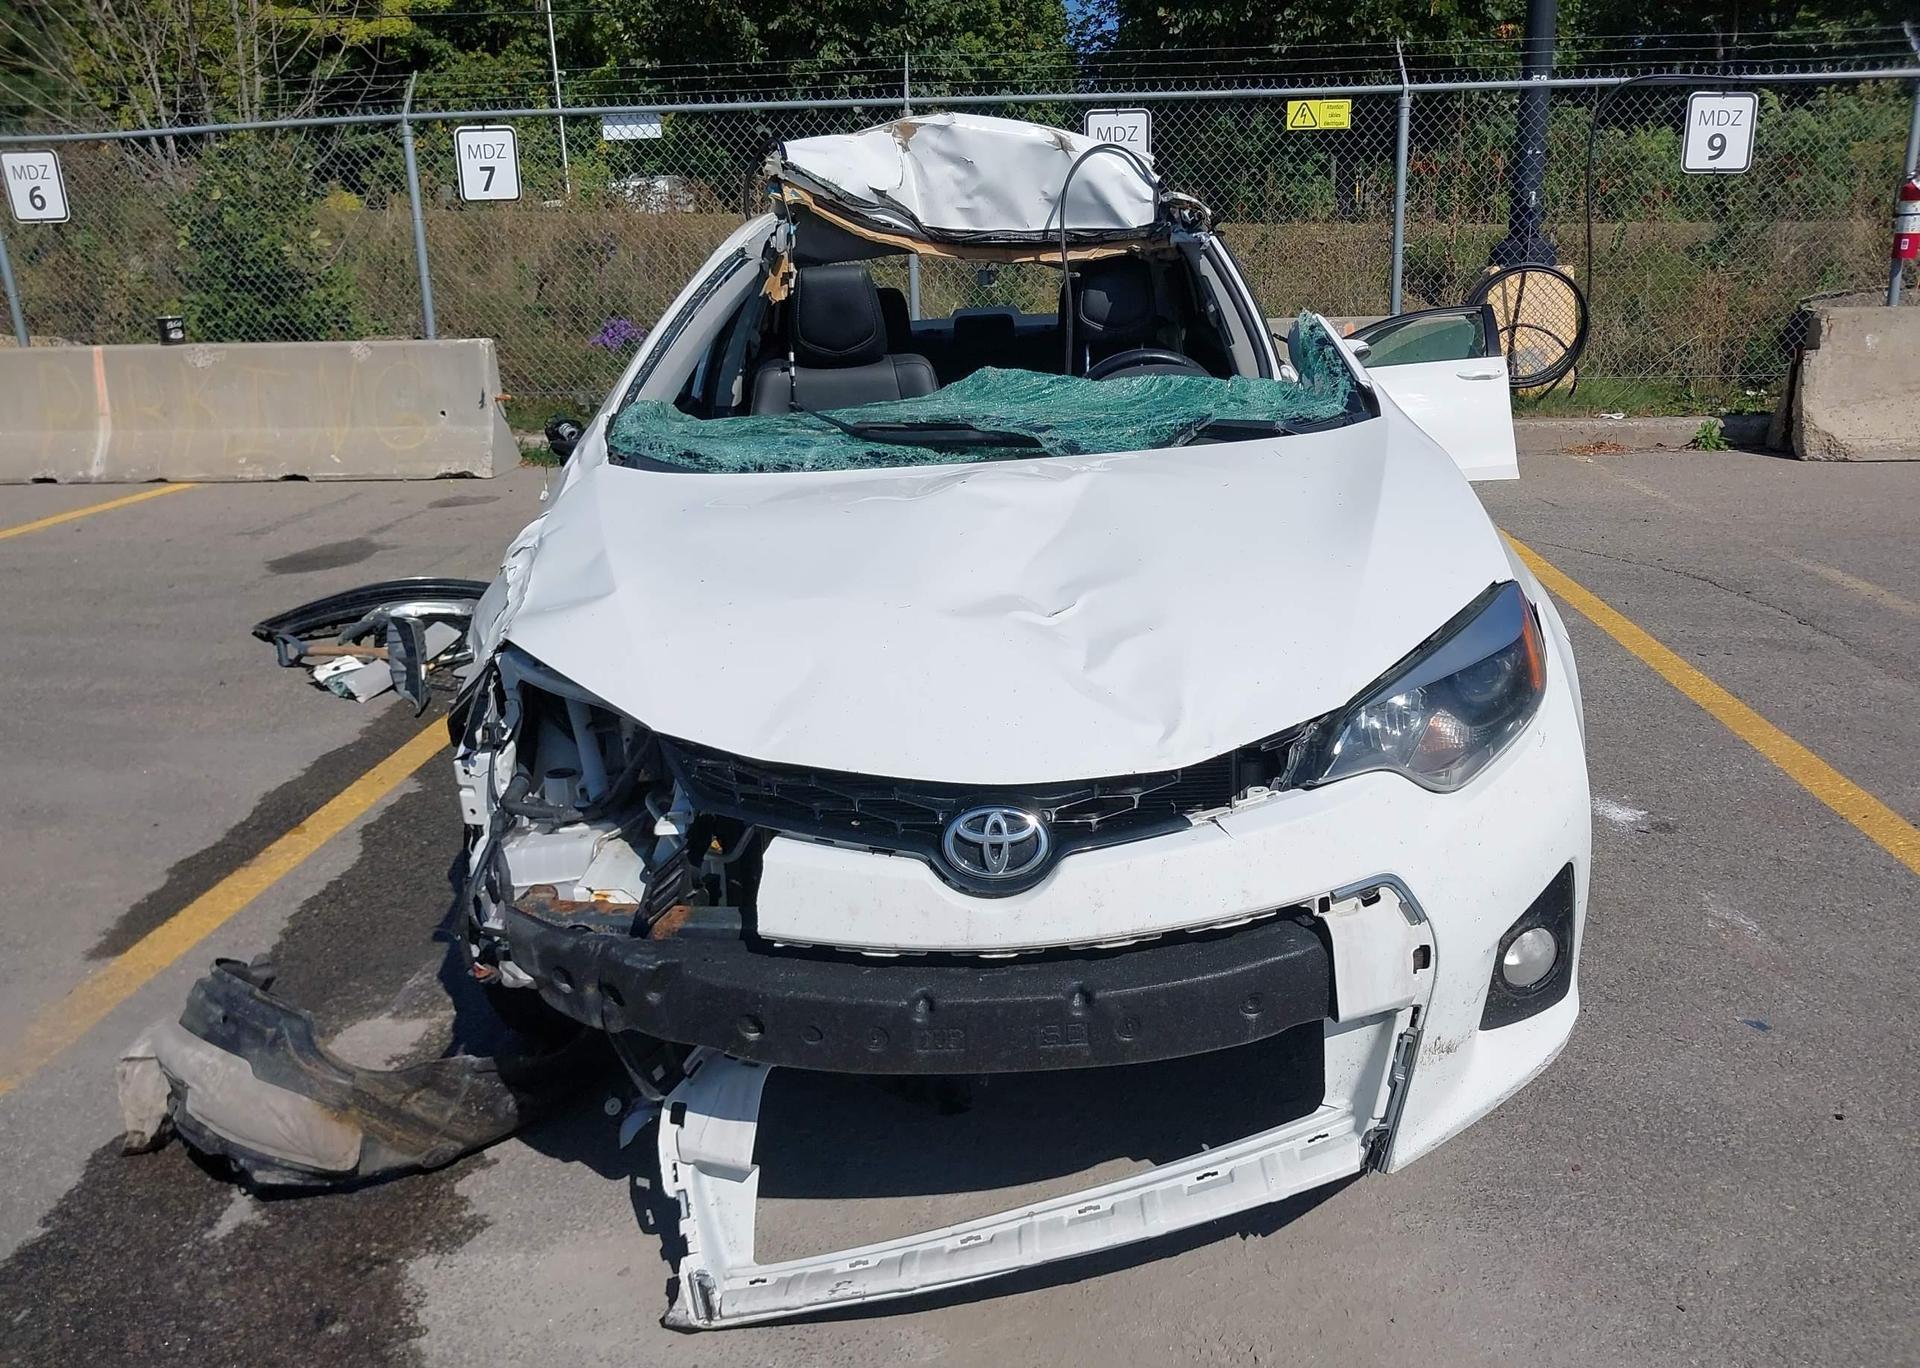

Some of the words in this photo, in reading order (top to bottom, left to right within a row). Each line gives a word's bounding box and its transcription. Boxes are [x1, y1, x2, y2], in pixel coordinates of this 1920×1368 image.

[1698, 110, 1744, 127] MDZ
[1096, 125, 1139, 143] MDZ
[467, 143, 508, 160] MDZ
[1707, 132, 1727, 161] 9
[11, 164, 52, 181] MDZ
[479, 166, 496, 192] 7
[29, 185, 47, 211] 6
